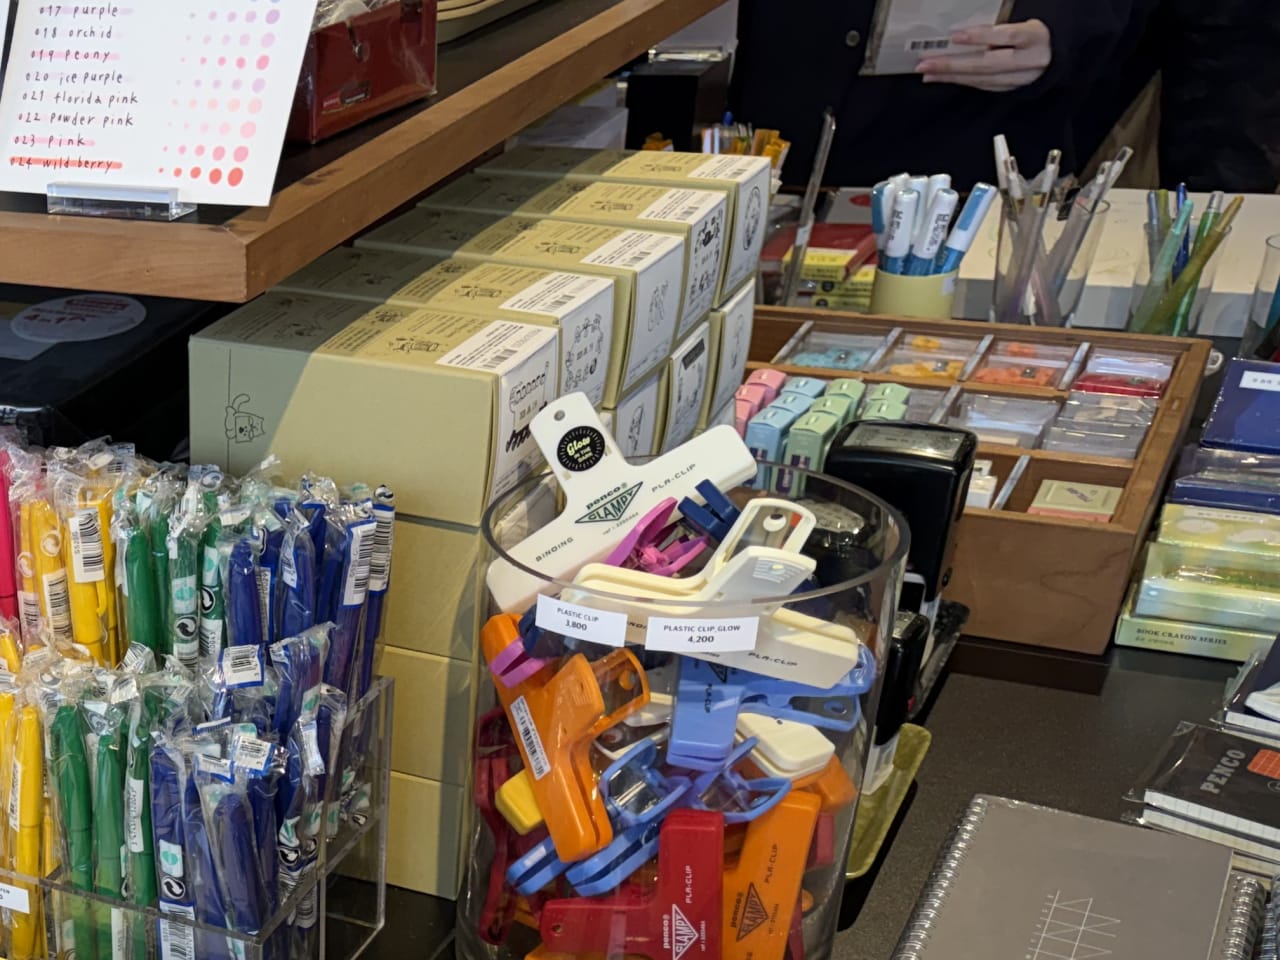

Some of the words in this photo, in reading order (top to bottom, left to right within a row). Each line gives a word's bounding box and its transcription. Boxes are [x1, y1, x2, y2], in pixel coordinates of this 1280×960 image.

[39, 5, 62, 17] 017
[73, 3, 118, 20] purple
[35, 27, 57, 38] 018
[69, 25, 112, 38] orchid
[31, 49, 54, 61] 019
[65, 50, 110, 63] peony
[25, 71, 49, 81] 020
[60, 72, 77, 85] ice
[83, 70, 123, 85] purple
[22, 90, 44, 101] 021
[54, 90, 101, 104] florida
[109, 91, 138, 108] pink
[18, 112, 40, 123] 022
[50, 112, 95, 126] powder
[103, 113, 134, 128] pink
[14, 134, 35, 147] 023
[48, 133, 85, 148] pink
[42, 156, 69, 169] wild
[77, 157, 112, 173] berry
[566, 436, 591, 456] Glow
[651, 463, 697, 493] PLA-CLIP
[588, 490, 634, 520] CLAMPY
[535, 537, 574, 562] BINDING
[557, 606, 582, 621] PLASTIC
[583, 613, 599, 622] CLIP
[664, 624, 695, 633] PLASTIC
[717, 624, 741, 632] GLOW
[1136, 628, 1159, 637] BOOK
[1162, 631, 1198, 642] CRAYON
[1200, 636, 1228, 646] SERIES
[747, 651, 799, 668] PLA-CLIP
[1200, 749, 1246, 794] PENCO
[676, 914, 694, 953] CLAMPY
